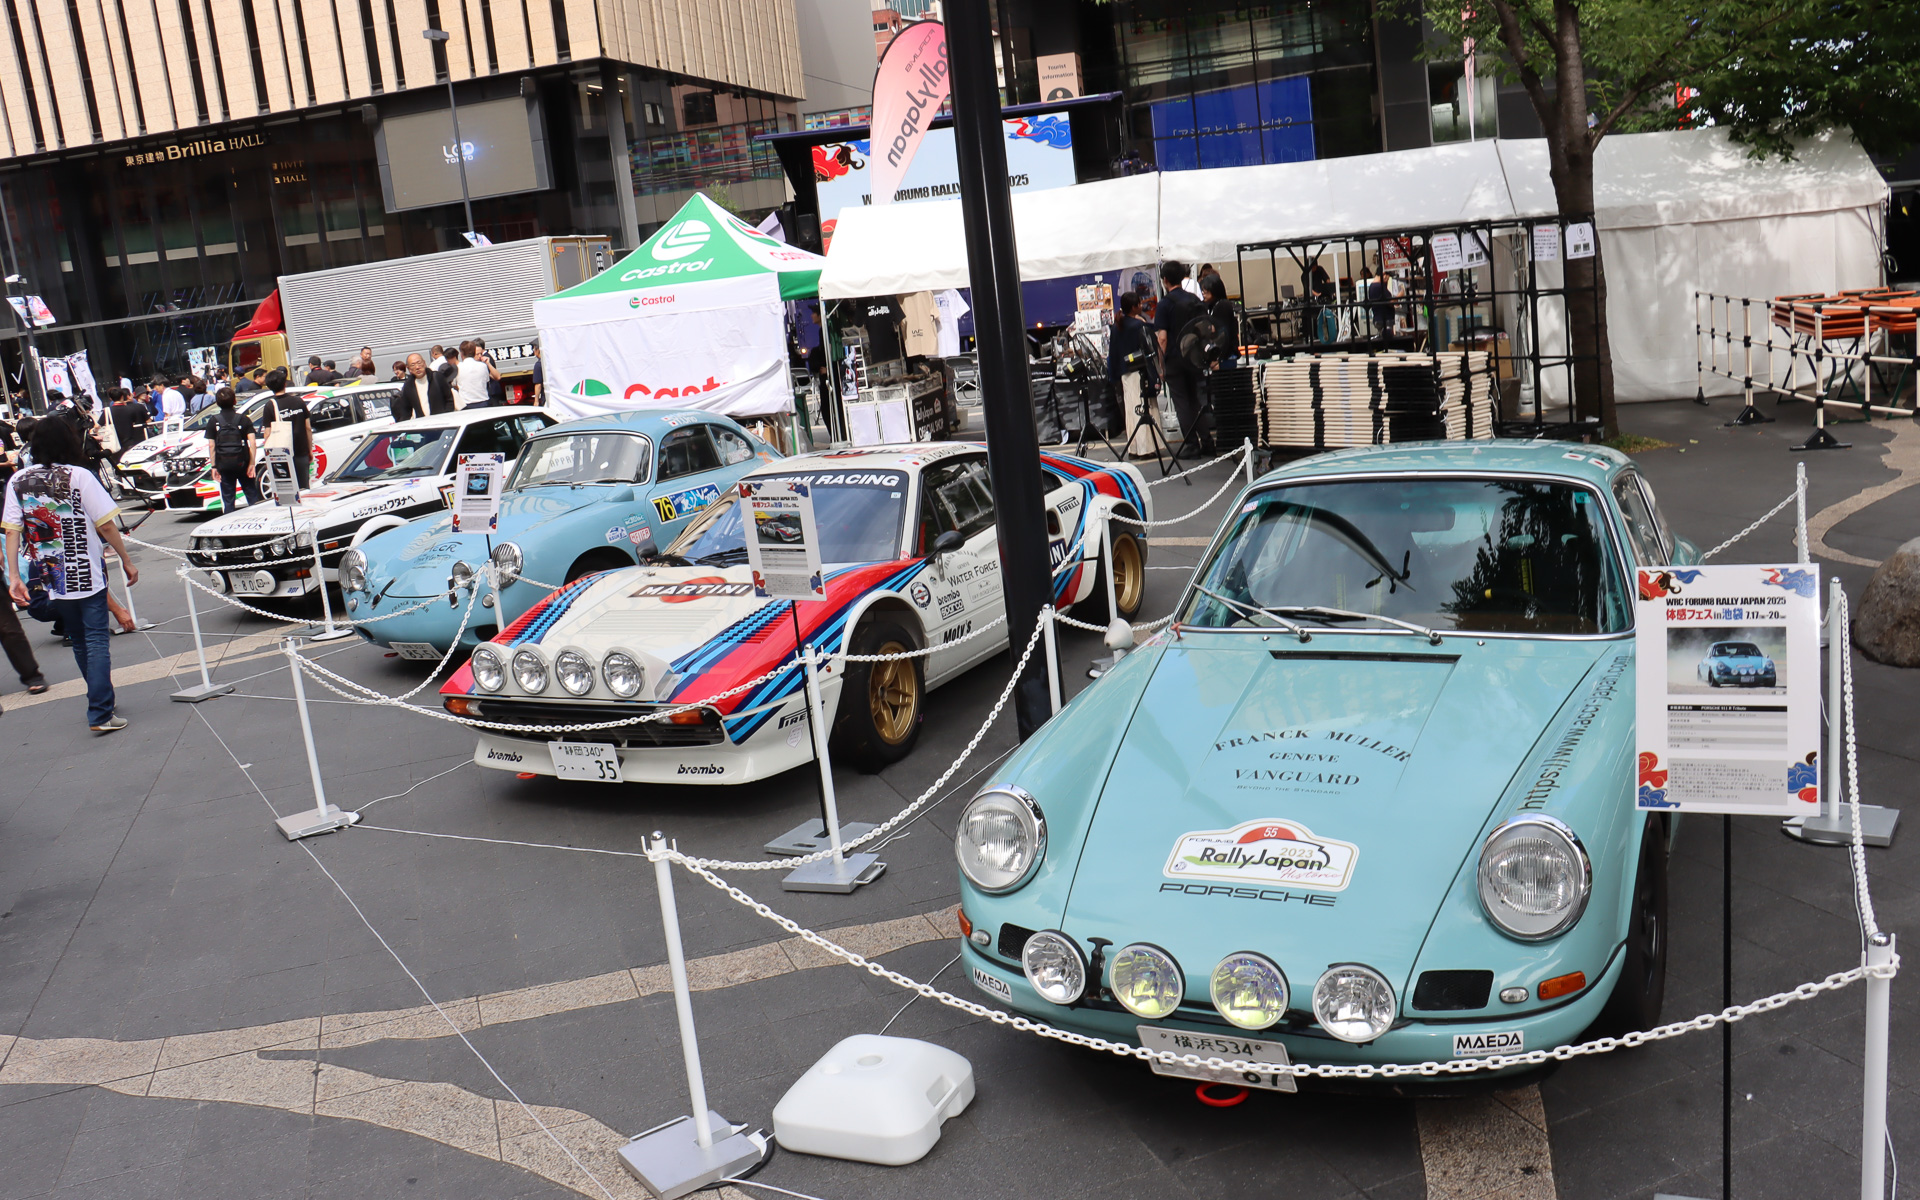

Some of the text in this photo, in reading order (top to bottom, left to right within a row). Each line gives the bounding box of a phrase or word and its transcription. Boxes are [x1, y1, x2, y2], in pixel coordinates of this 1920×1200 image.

[125, 134, 265, 167] 東京建物 Brillia HALL
[1008, 173, 1030, 188] 025
[641, 294, 675, 306] Castrol
[815, 473, 901, 487] RACING
[653, 497, 677, 522] 76
[73, 516, 89, 557] JAPAN
[65, 564, 79, 593] WRC
[77, 558, 93, 592] RALLY
[638, 584, 751, 596] MARTINI
[1666, 596, 1787, 606] WRC FORUM8 RALLY JAPAN 2025
[1214, 729, 1412, 763] FRANCK MULLER
[487, 748, 523, 764] brembo
[1269, 751, 1341, 763] GENEVE
[594, 759, 618, 780] 35
[677, 763, 726, 777] brembo
[1234, 768, 1361, 786] VANGUARD
[1263, 826, 1279, 838] 55
[1199, 846, 1324, 871] RallyJapan 2023
[1159, 882, 1338, 908] PORSCHE
[974, 968, 1011, 996] MAEDA
[1456, 1032, 1522, 1050] MAEDA
